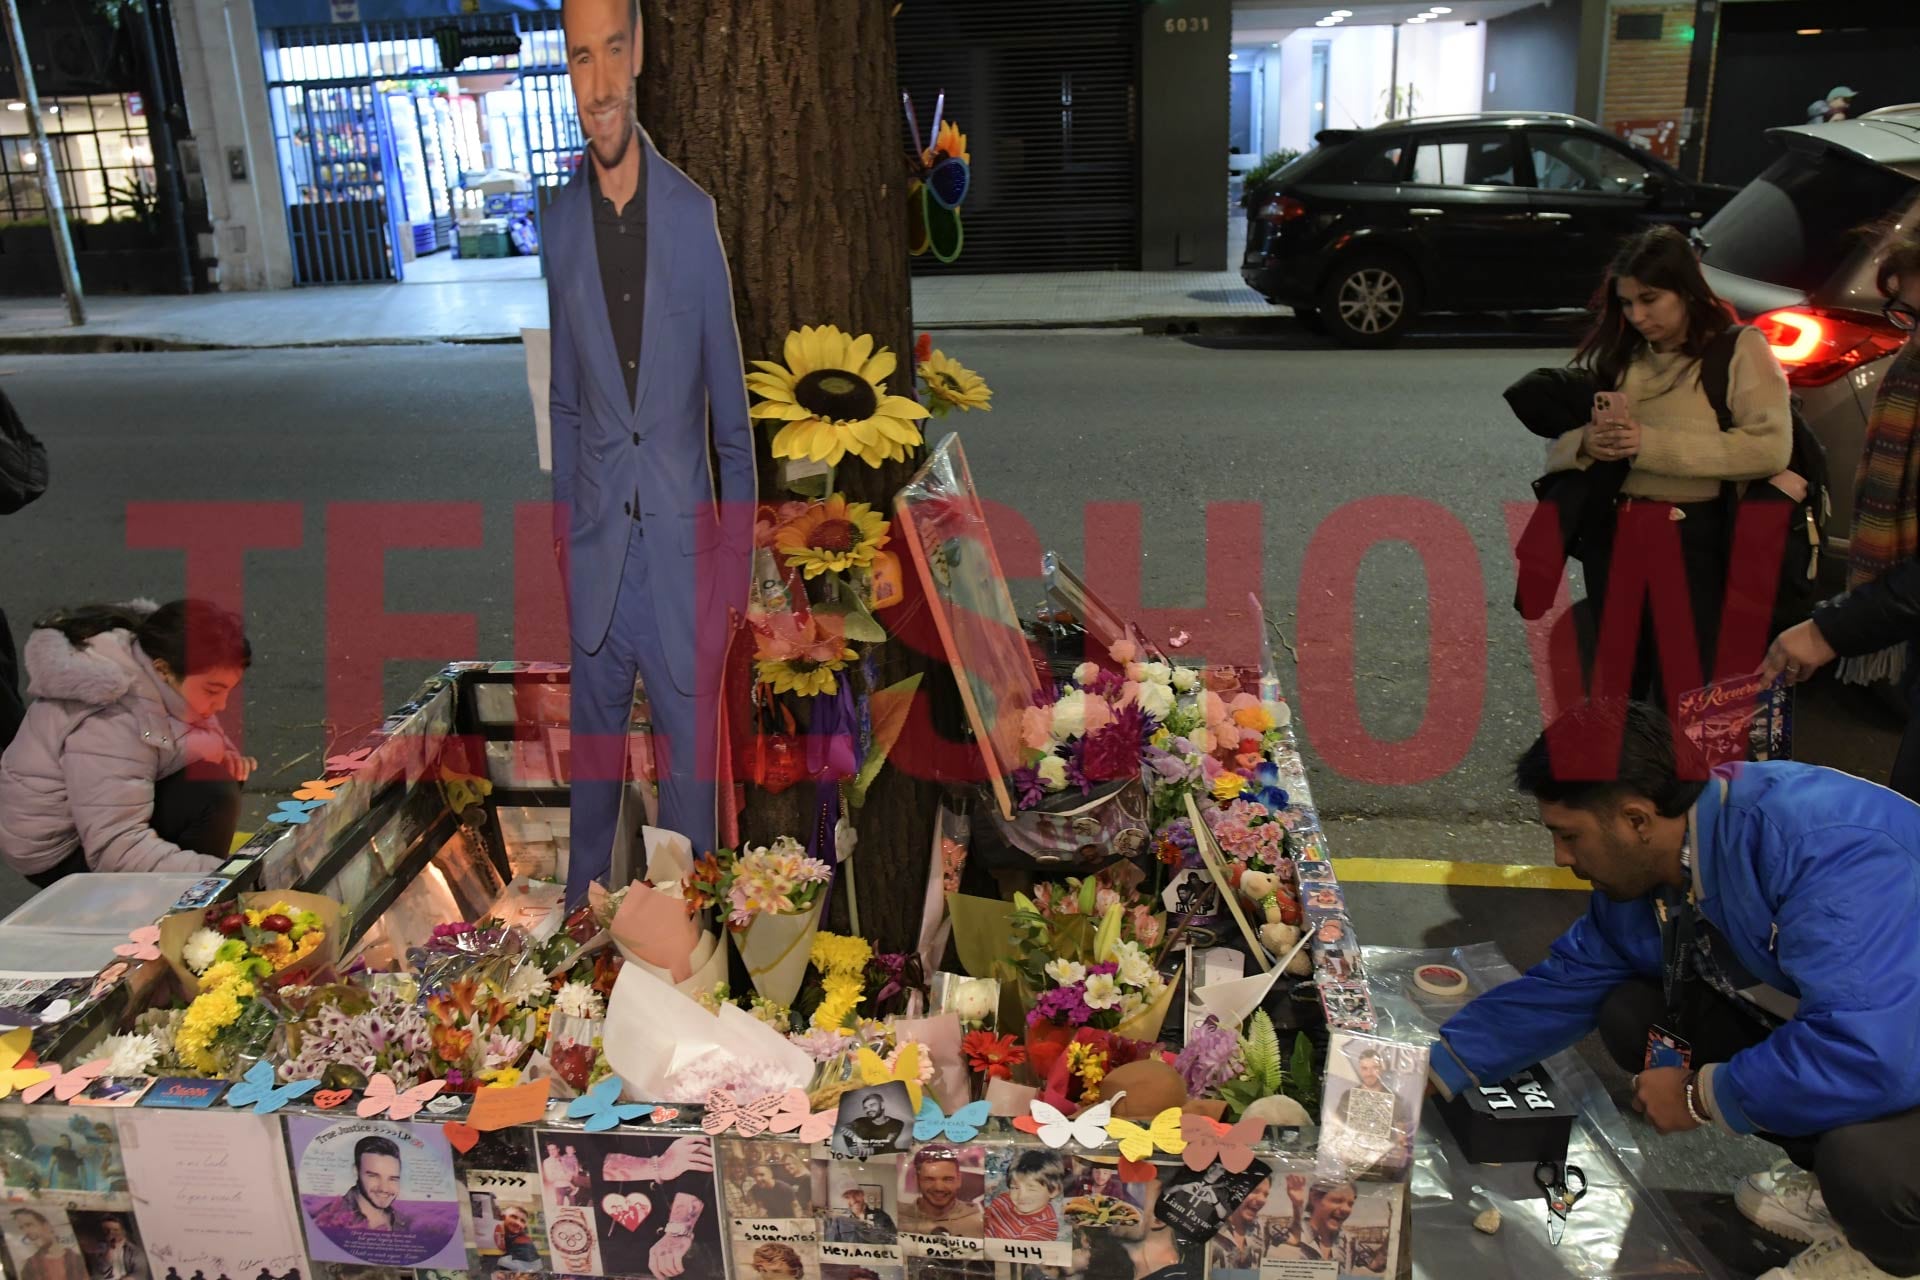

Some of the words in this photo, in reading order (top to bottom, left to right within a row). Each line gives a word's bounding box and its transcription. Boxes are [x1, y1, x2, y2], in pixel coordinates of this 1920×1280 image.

[1164, 17, 1209, 33] 6031
[339, 1124, 371, 1135] Justice
[1163, 1193, 1186, 1213] Liam
[1186, 1208, 1213, 1230] Payne
[1004, 1245, 1042, 1259] 444
